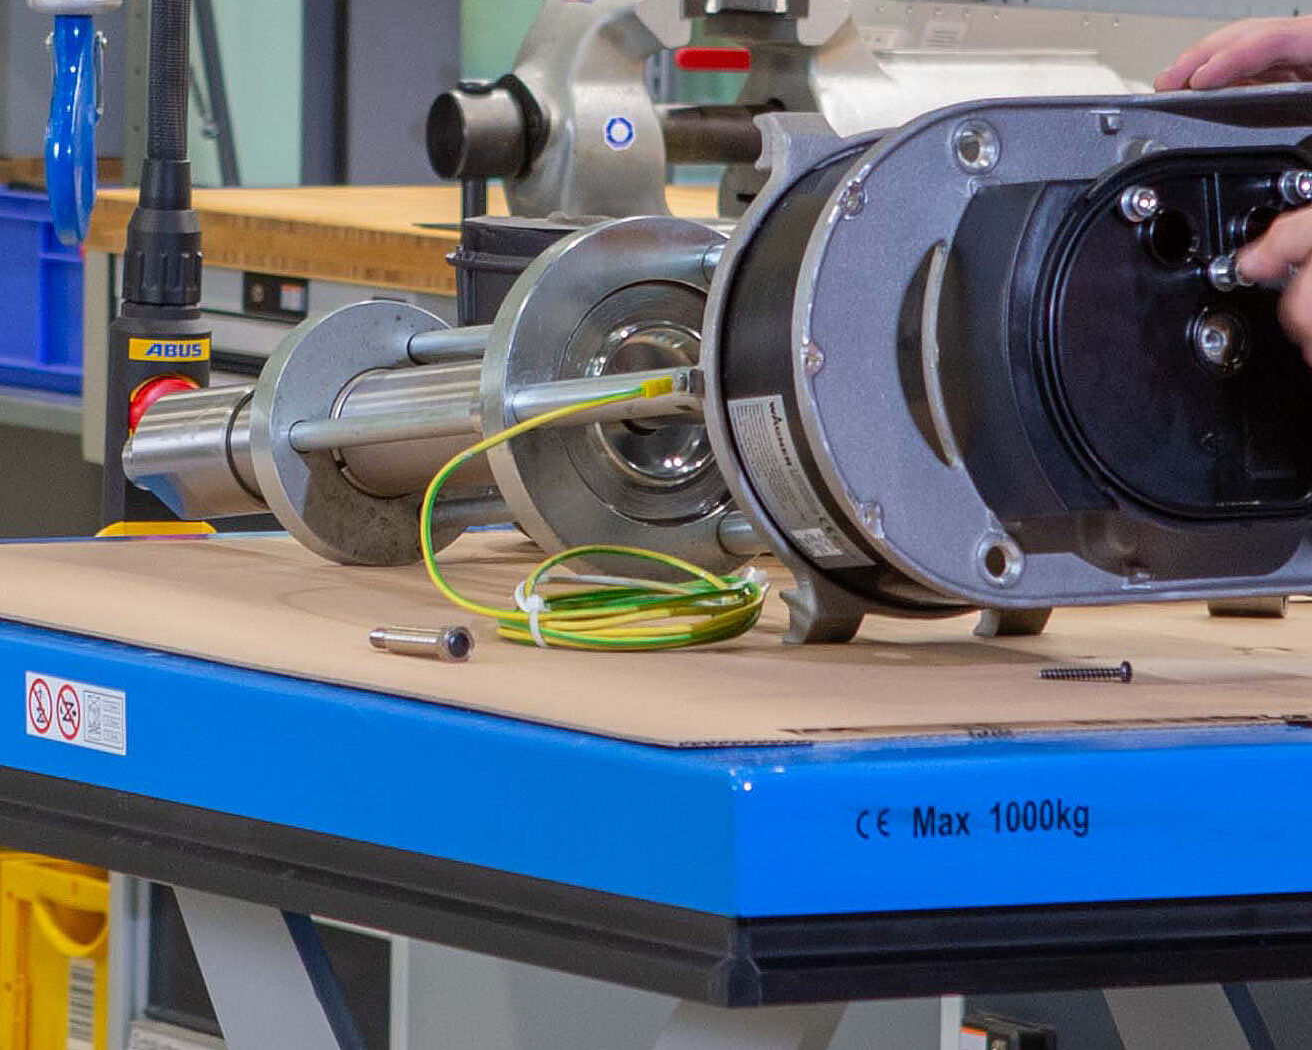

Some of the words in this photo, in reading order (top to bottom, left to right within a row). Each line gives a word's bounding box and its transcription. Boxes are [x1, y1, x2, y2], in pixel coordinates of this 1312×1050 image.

[146, 342, 202, 358] ABUS
[913, 805, 971, 839] Max
[990, 798, 1090, 838] 1000kg
